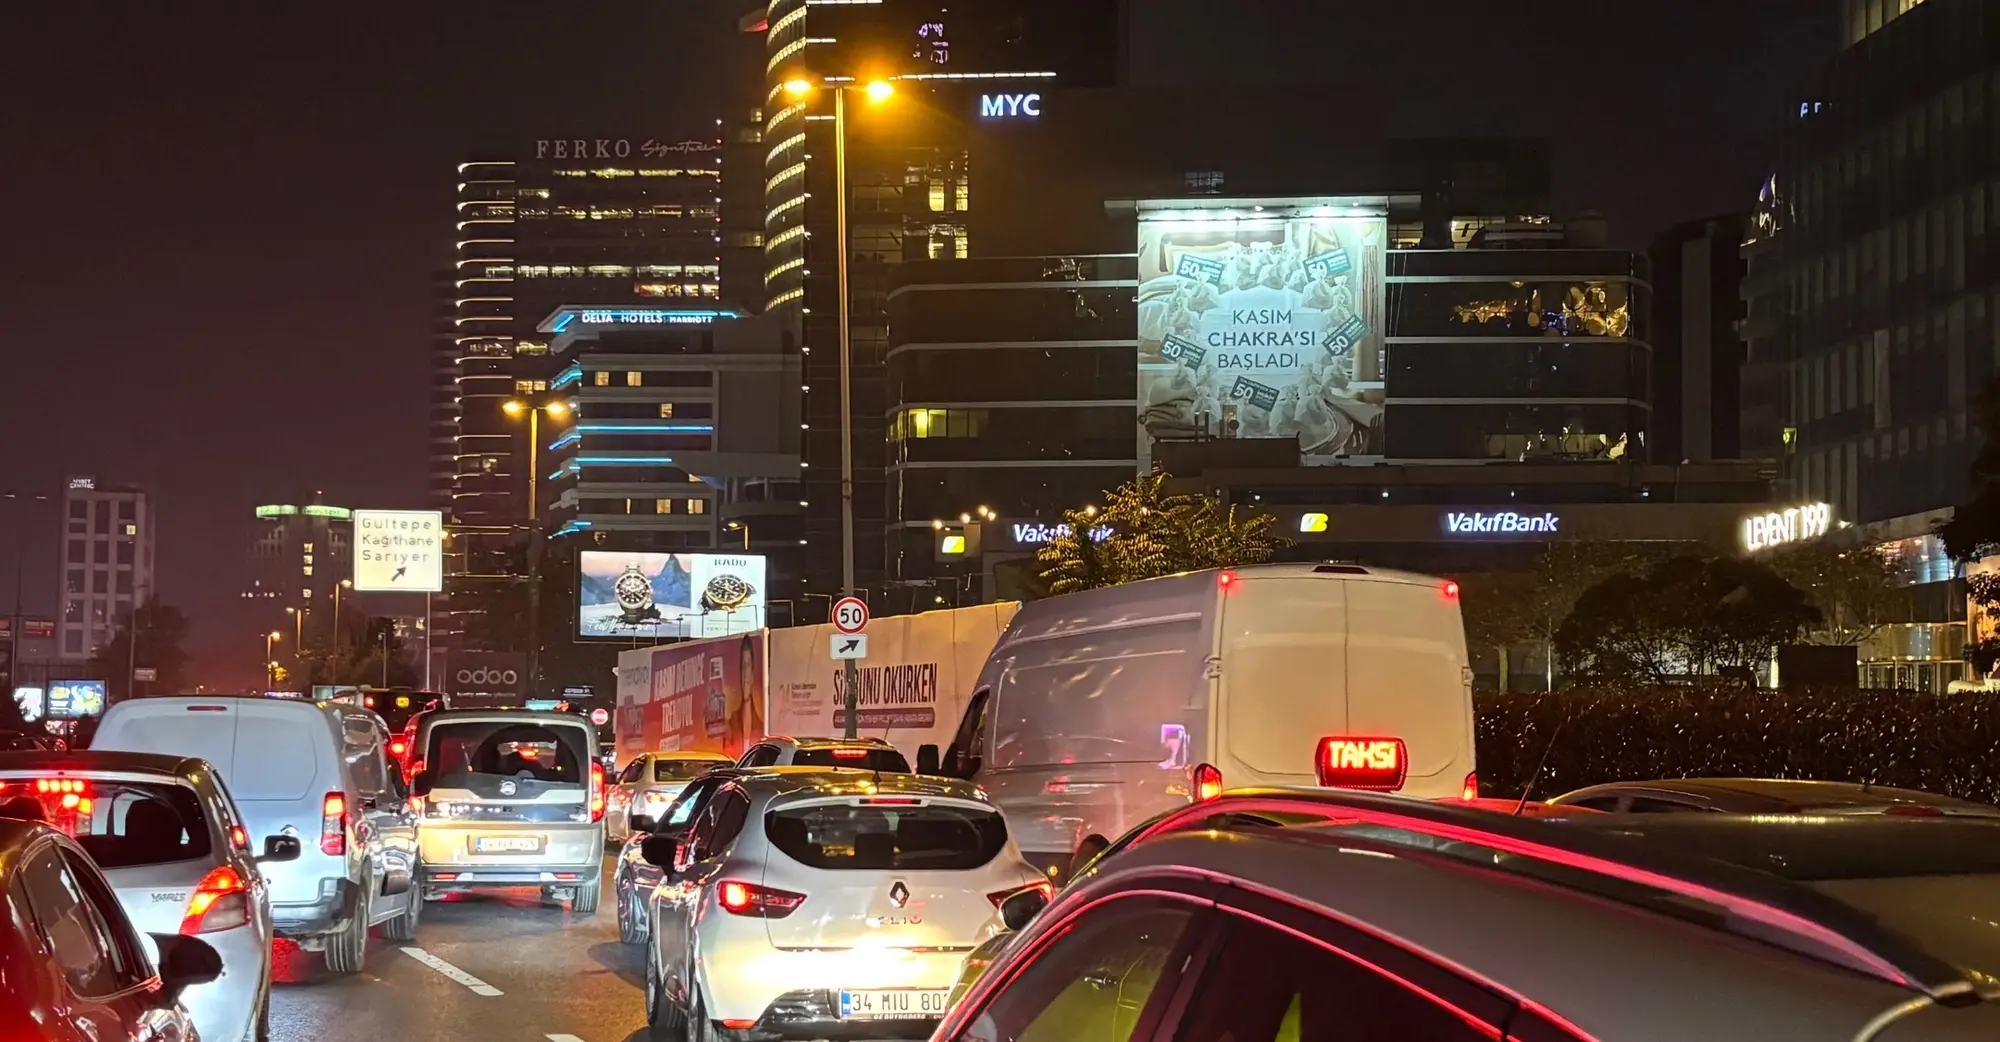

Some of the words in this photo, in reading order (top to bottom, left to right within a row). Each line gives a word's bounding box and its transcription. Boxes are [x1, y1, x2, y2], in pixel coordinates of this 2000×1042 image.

[982, 94, 1040, 116] MYC
[536, 139, 631, 159] FERKO
[582, 313, 613, 323] DELTA
[621, 313, 663, 323] HOTELS
[669, 315, 713, 324] MARRIOTT
[1233, 309, 1292, 325] KASIM
[1208, 331, 1315, 346] CHAKRA'SI
[1329, 335, 1349, 354] 50
[1162, 340, 1181, 358] 50
[1218, 353, 1298, 370] BAŞLADI
[1234, 383, 1254, 399] 50
[1447, 512, 1560, 532] VakıfBank
[1745, 508, 1800, 552] LEVENT
[1800, 501, 1830, 540] 199
[714, 558, 747, 567] RADO
[840, 608, 862, 624] 50
[457, 666, 517, 684] odoo
[884, 663, 938, 704] OKURKEN
[853, 993, 872, 1011] 34
[882, 993, 909, 1011] MIU
